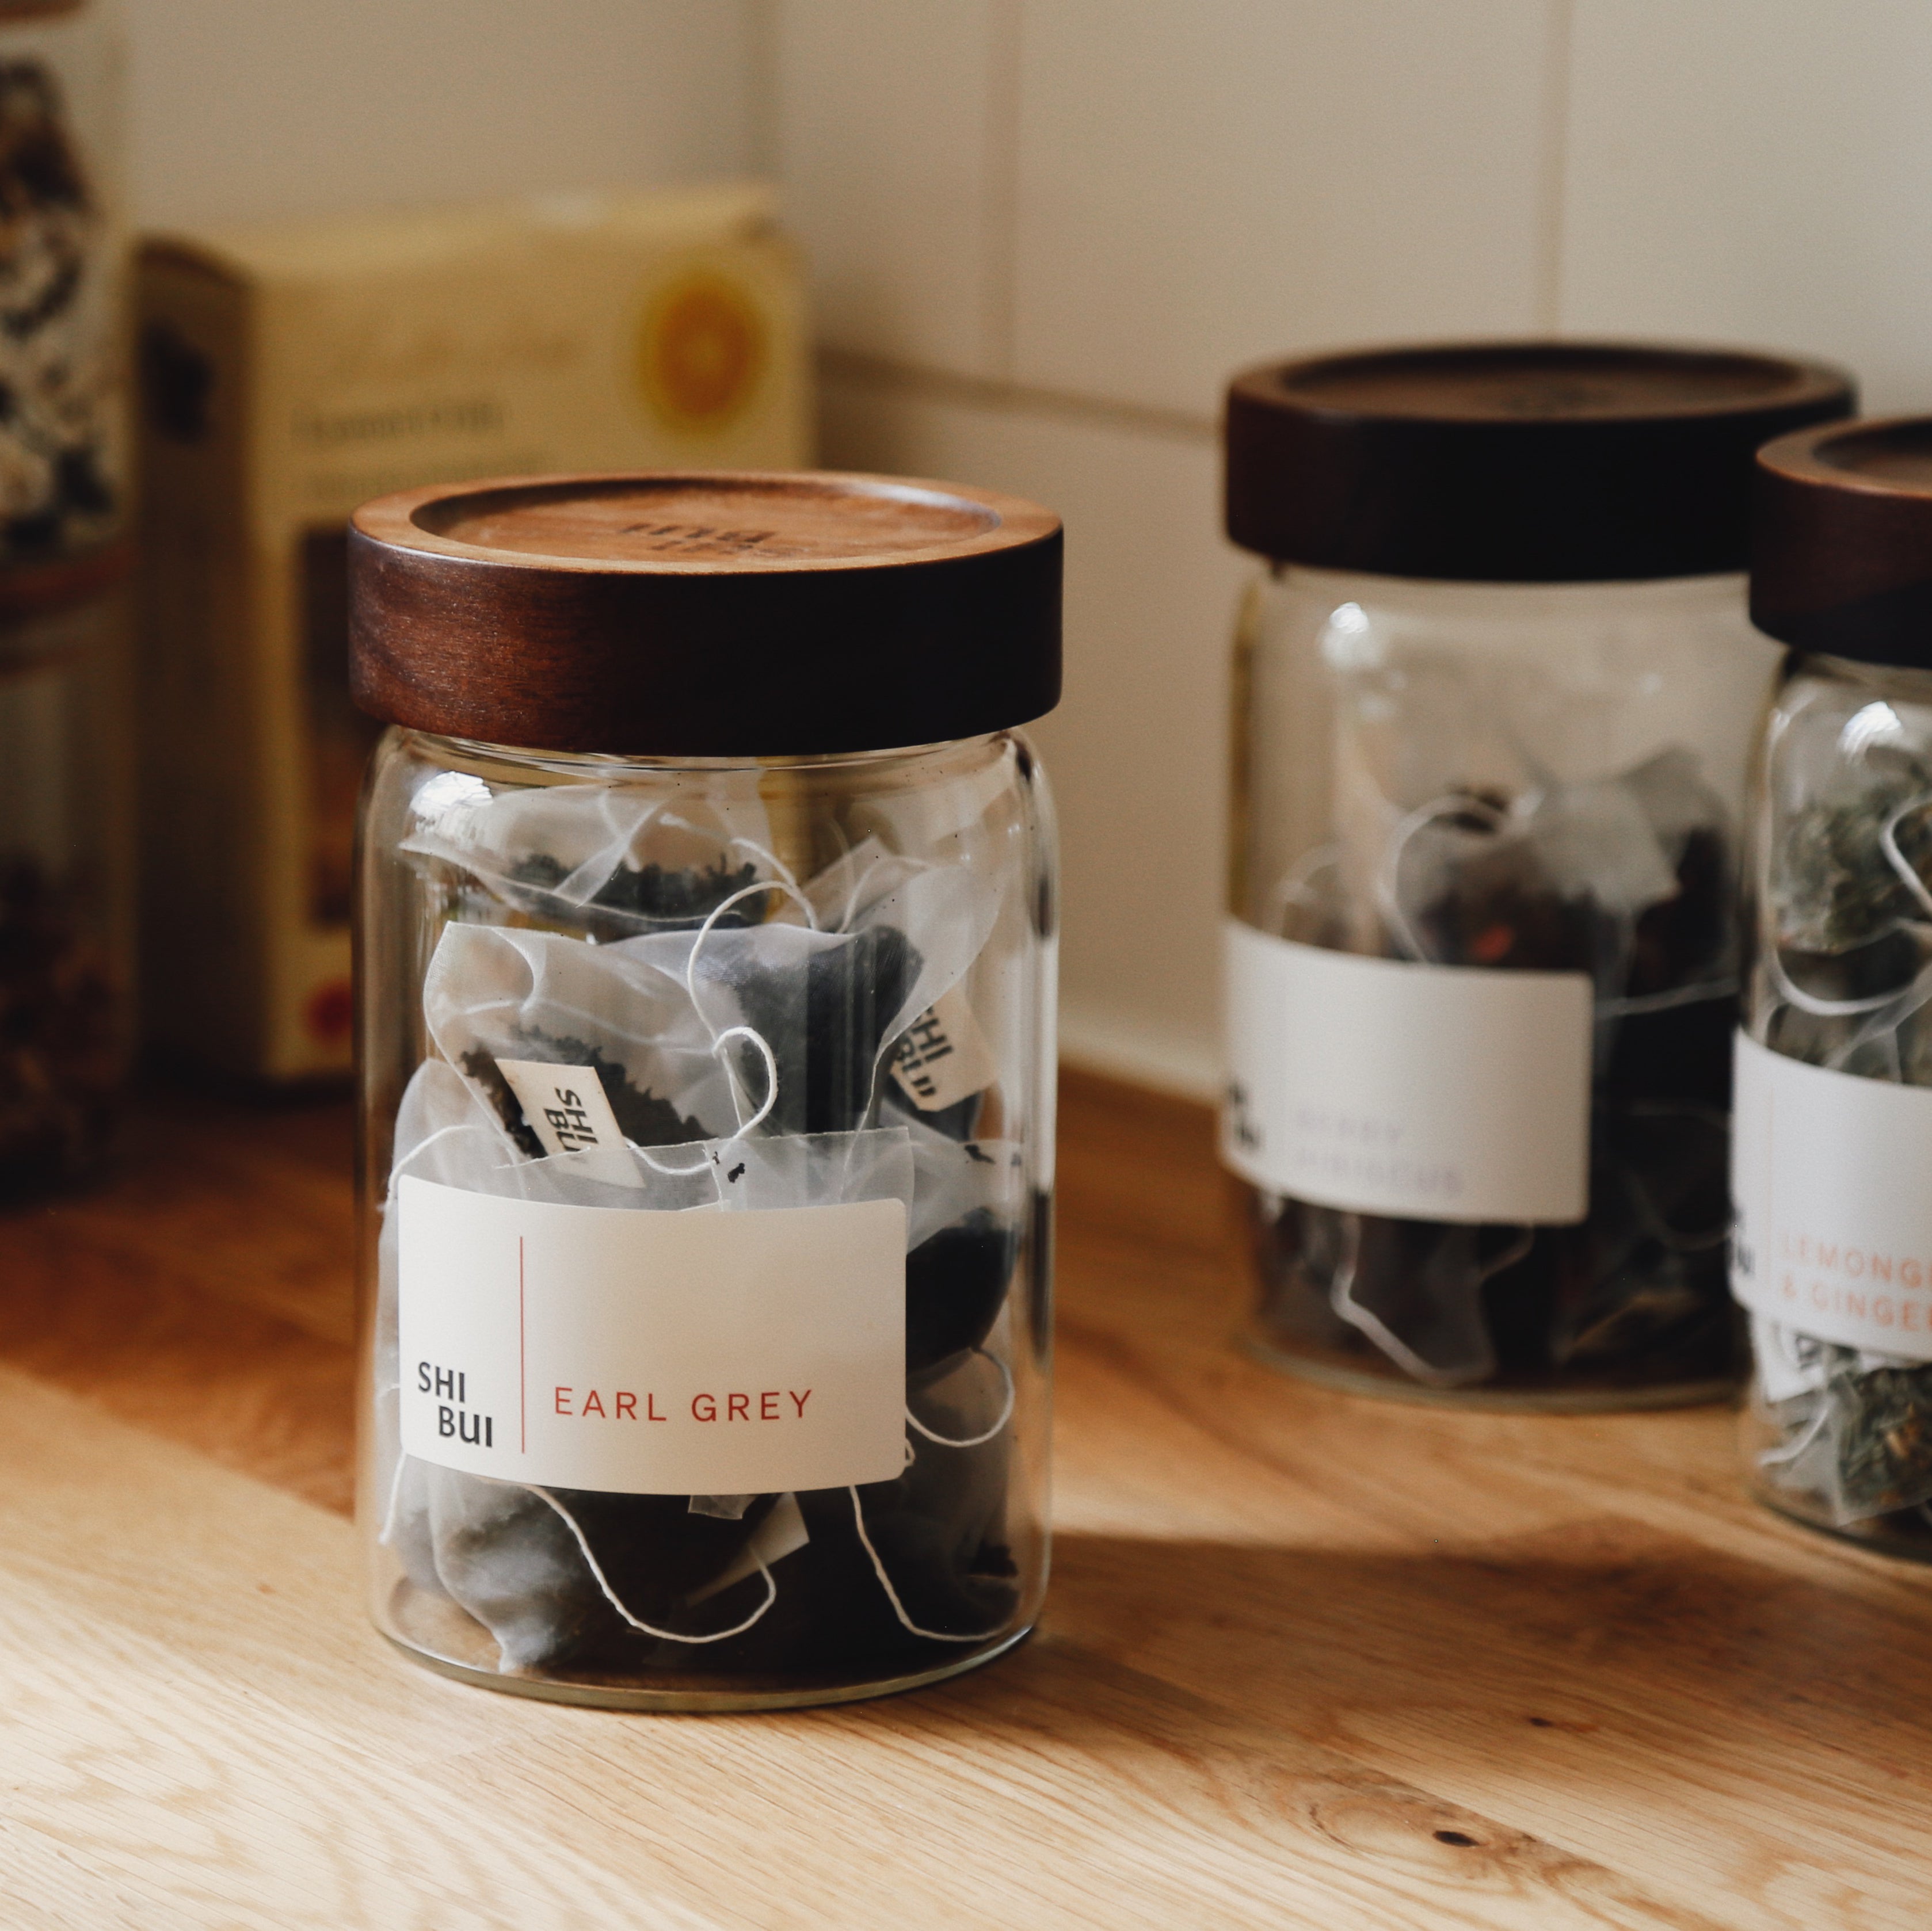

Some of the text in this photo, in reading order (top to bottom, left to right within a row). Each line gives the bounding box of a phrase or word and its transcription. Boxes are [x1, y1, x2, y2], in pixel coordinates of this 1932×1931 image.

[911, 1006, 953, 1062] HI
[544, 1108, 584, 1154] BU
[554, 1087, 599, 1144] SHI
[1783, 1233, 1932, 1290] LEMONG
[418, 1361, 465, 1403] SHI
[555, 1387, 812, 1422] EARL GREY
[439, 1405, 493, 1448] BUI
